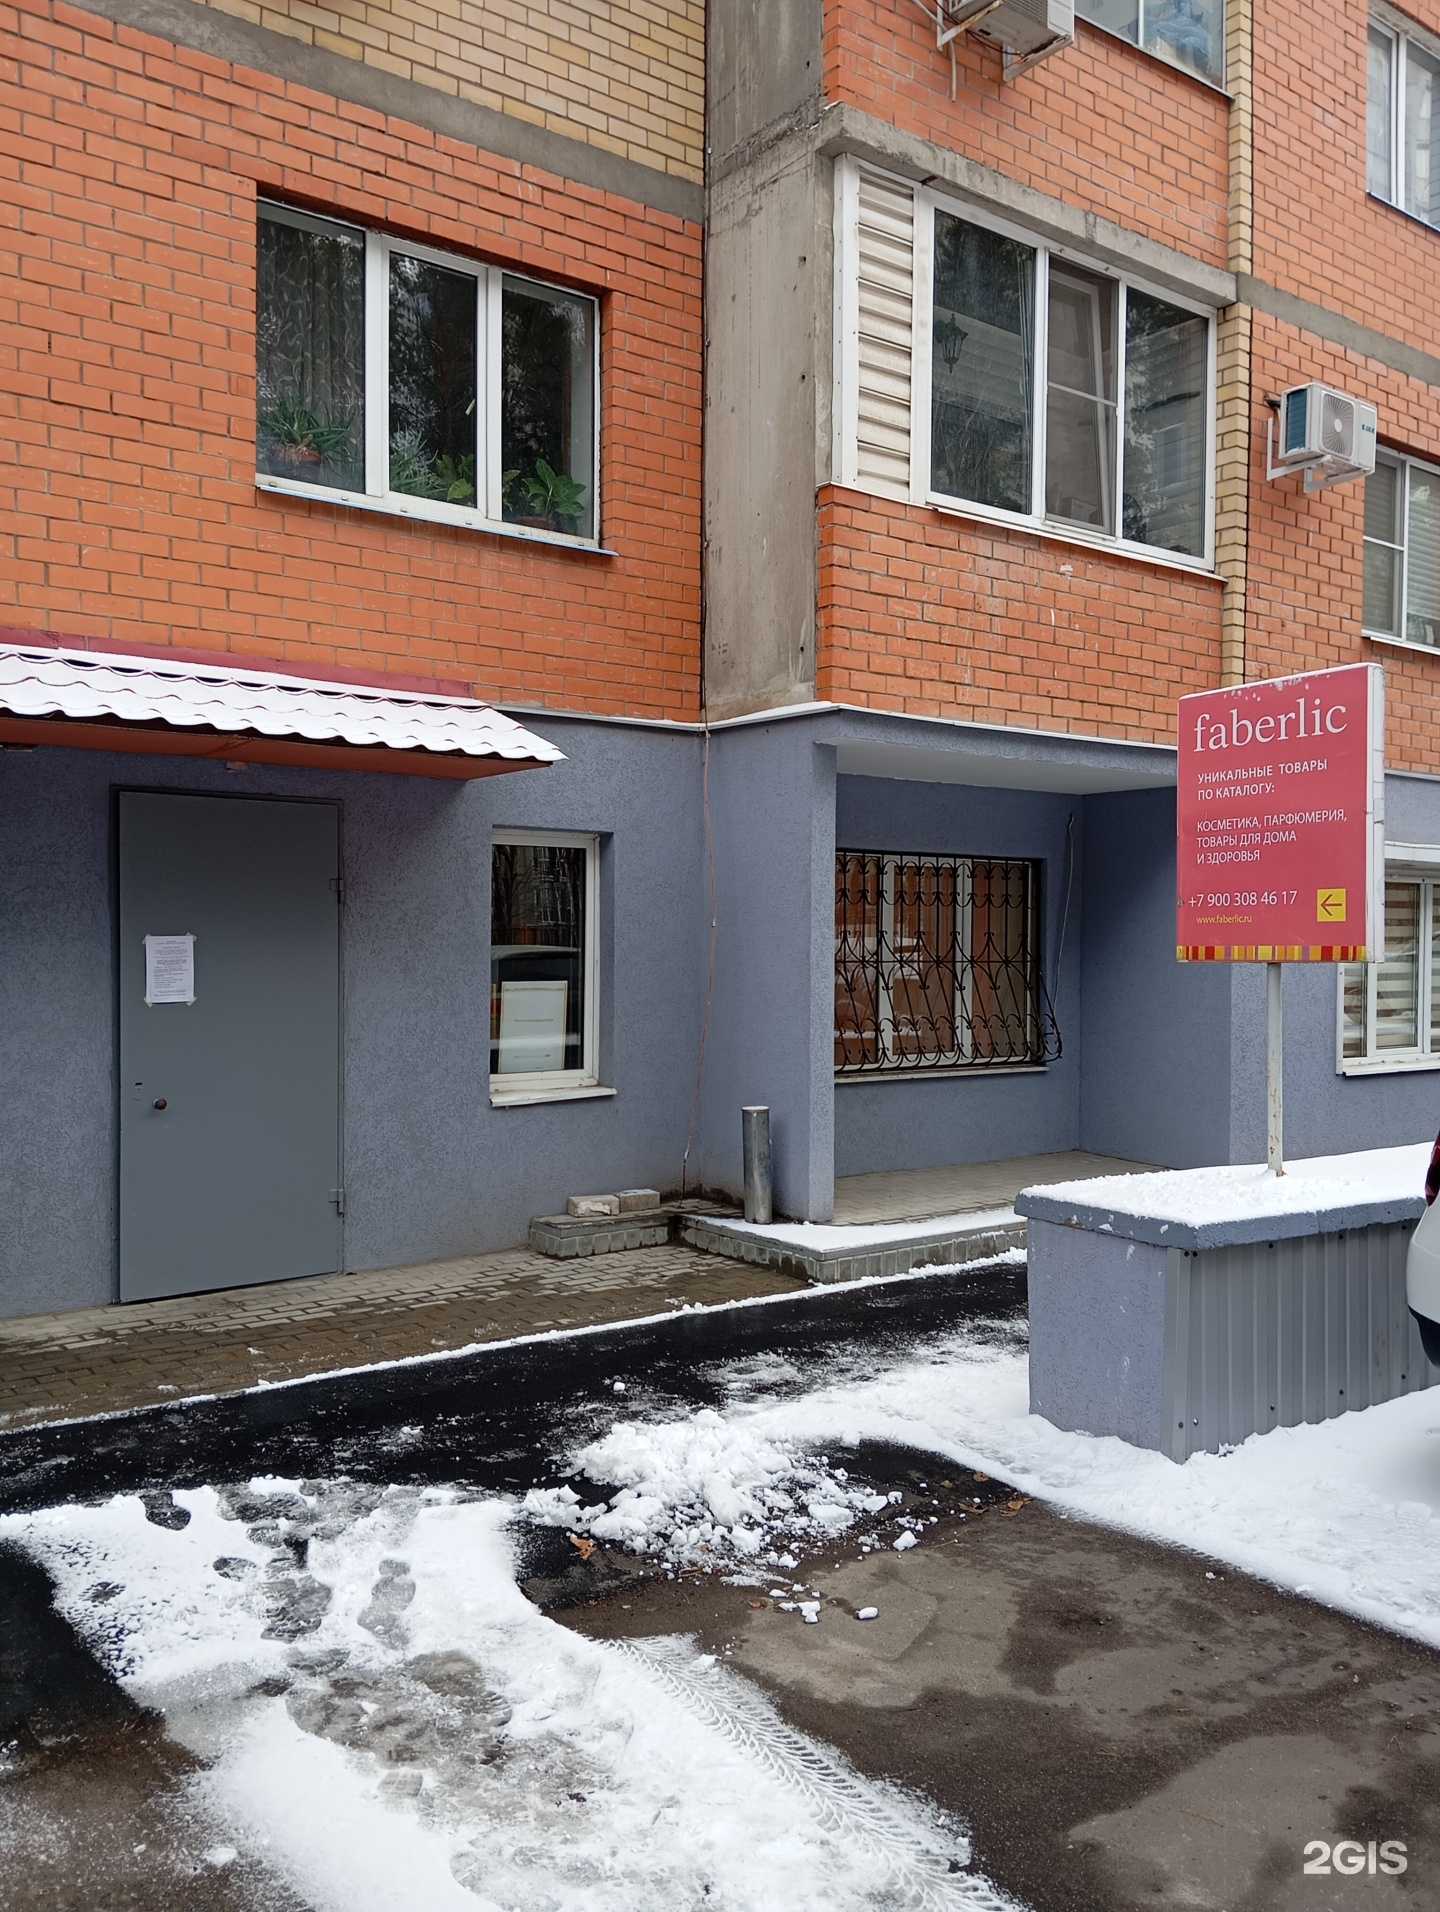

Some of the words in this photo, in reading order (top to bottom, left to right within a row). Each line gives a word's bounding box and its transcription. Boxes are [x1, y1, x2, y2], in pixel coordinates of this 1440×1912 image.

[1193, 697, 1348, 752] faberlic
[1198, 765, 1273, 784] УНИКАЛЬНЫЕ
[1278, 758, 1328, 774] ТОВАРЫ
[1198, 789, 1213, 800] ПО
[1216, 782, 1275, 798] КАТАЛОГУ:
[1197, 816, 1262, 832] КОСМЕТИКА,
[1264, 808, 1347, 826] ПАРФЮМЕРИЯ,
[1196, 834, 1237, 848] ТОВАРЫ
[1239, 832, 1261, 847] ДЛЯ
[1263, 830, 1297, 845] ДОМА
[1197, 853, 1205, 865] И
[1206, 849, 1260, 865] ЗДОРОВЬЯ
[1188, 894, 1204, 907] +7
[1207, 893, 1230, 907] 900
[1233, 892, 1258, 906] 308
[1261, 891, 1278, 905] 46
[1282, 890, 1298, 905] 17
[1196, 914, 1252, 924] www.faberlic.ru
